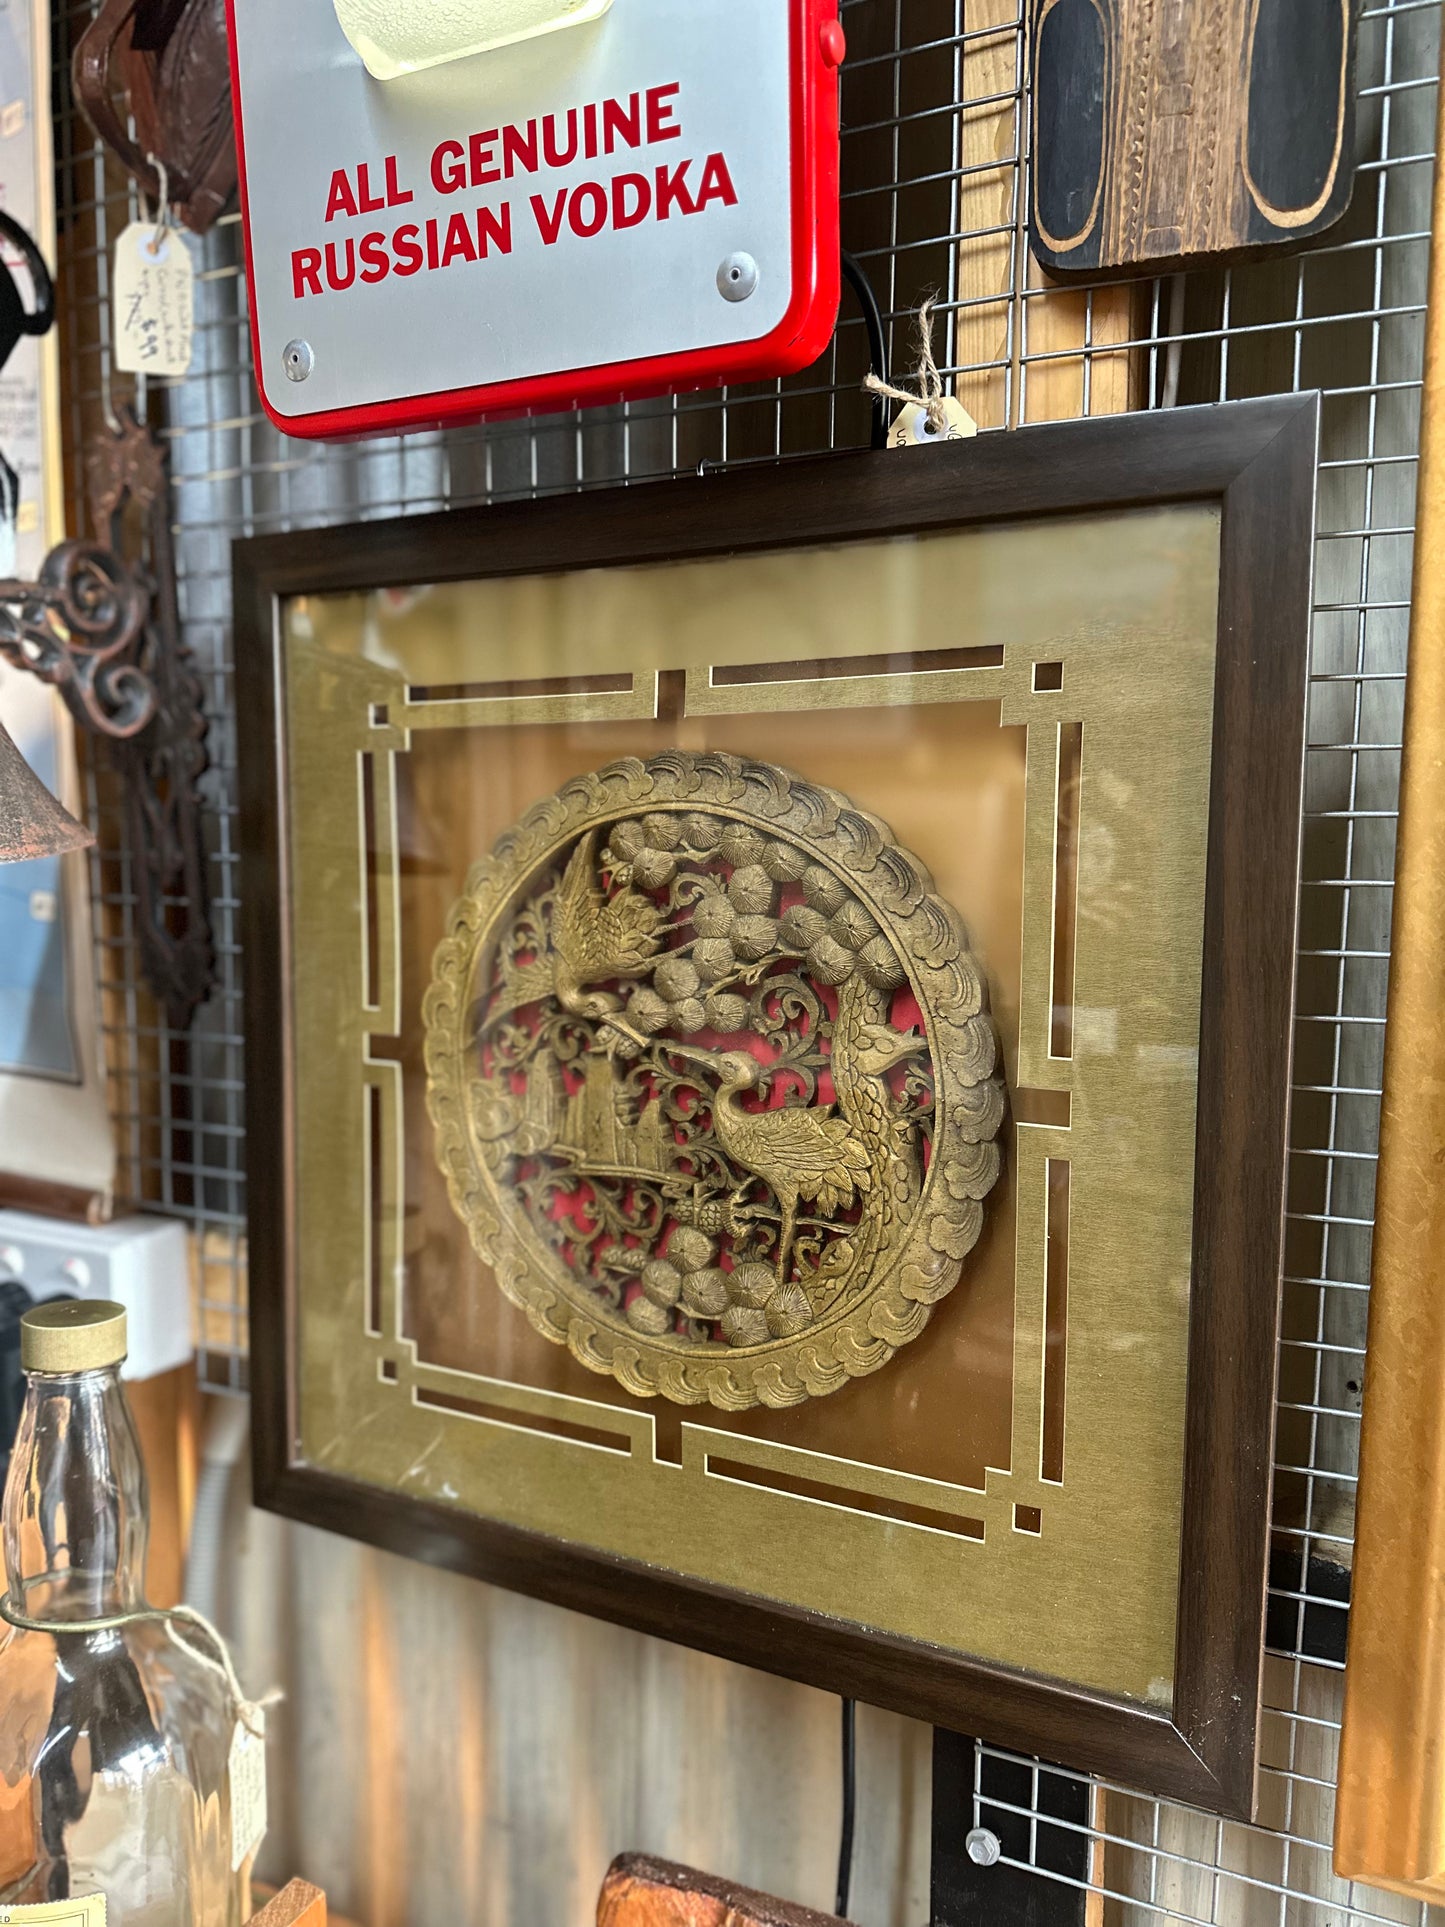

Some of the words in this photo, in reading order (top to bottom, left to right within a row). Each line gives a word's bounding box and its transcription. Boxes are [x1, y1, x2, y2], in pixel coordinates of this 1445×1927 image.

[325, 155, 414, 223] ALL
[430, 82, 682, 195] GENUINE
[291, 201, 513, 299] RUSSIAN
[529, 152, 739, 246] VODKA
